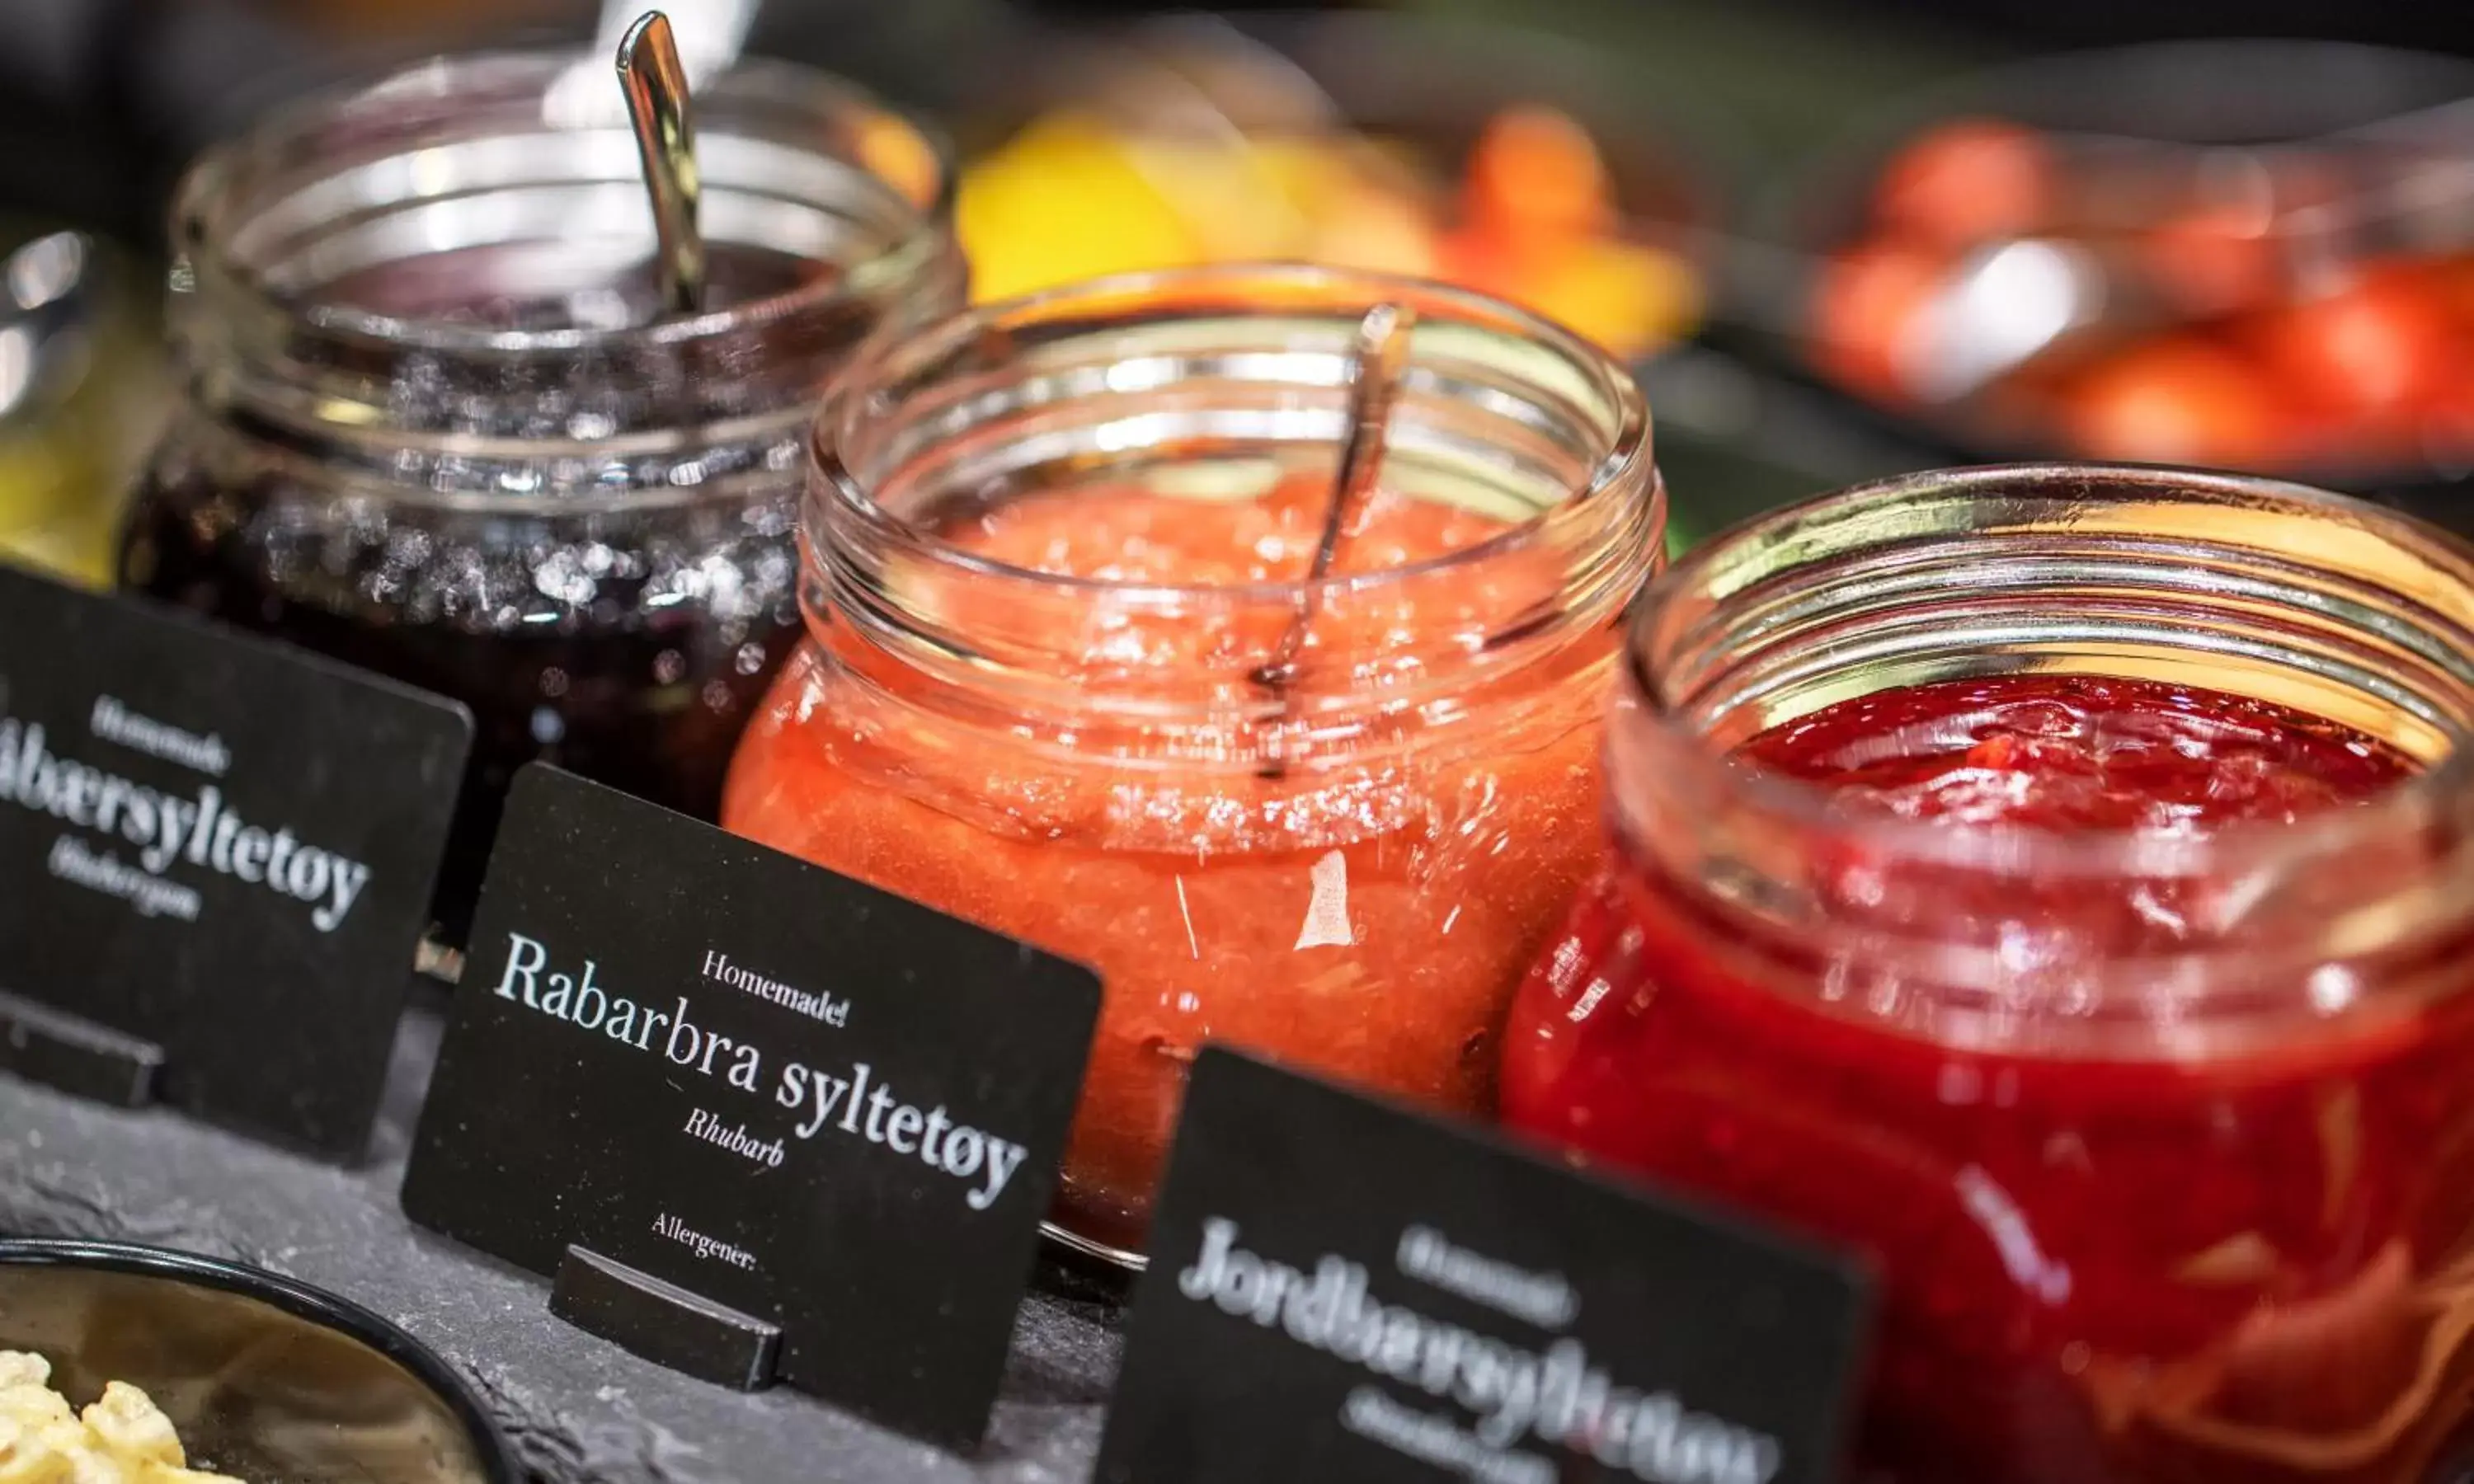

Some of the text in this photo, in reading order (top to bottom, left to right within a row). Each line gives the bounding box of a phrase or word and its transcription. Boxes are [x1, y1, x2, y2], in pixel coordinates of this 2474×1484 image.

[701, 949, 851, 1029] Homemade!
[492, 932, 1028, 1210] Rabarbra syltetøy
[682, 1107, 785, 1168] Rhubarb
[651, 1212, 758, 1271] Allergener:
